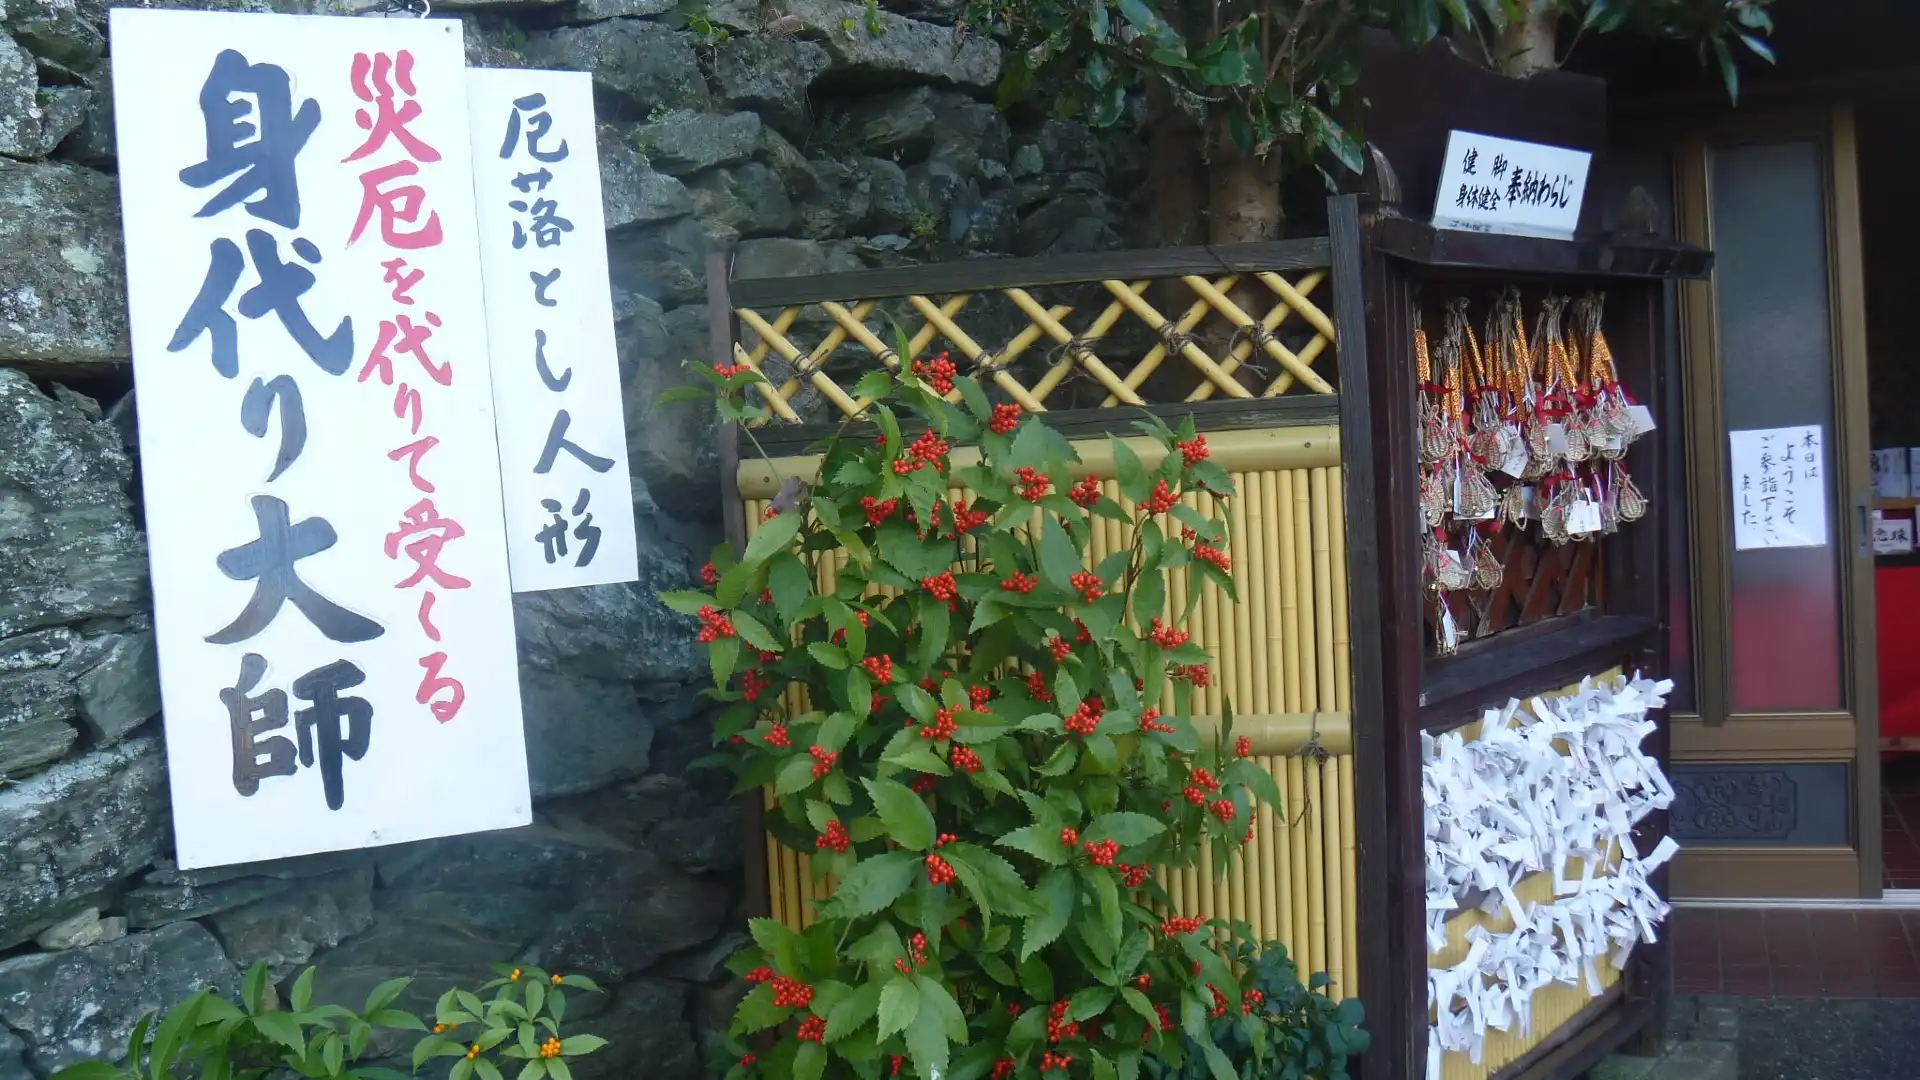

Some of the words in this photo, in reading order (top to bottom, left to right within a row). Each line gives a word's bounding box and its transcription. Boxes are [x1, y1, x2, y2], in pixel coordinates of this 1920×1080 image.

[1456, 183, 1501, 211] 身体健全
[1504, 165, 1573, 209] 奉納わらじ
[499, 93, 616, 568] 厄落とし人形
[340, 49, 471, 724] 災厄を代りて受くる
[166, 48, 386, 811] 身代り大師
[1800, 431, 1820, 479] 本日は
[1780, 443, 1796, 525] ようこそ
